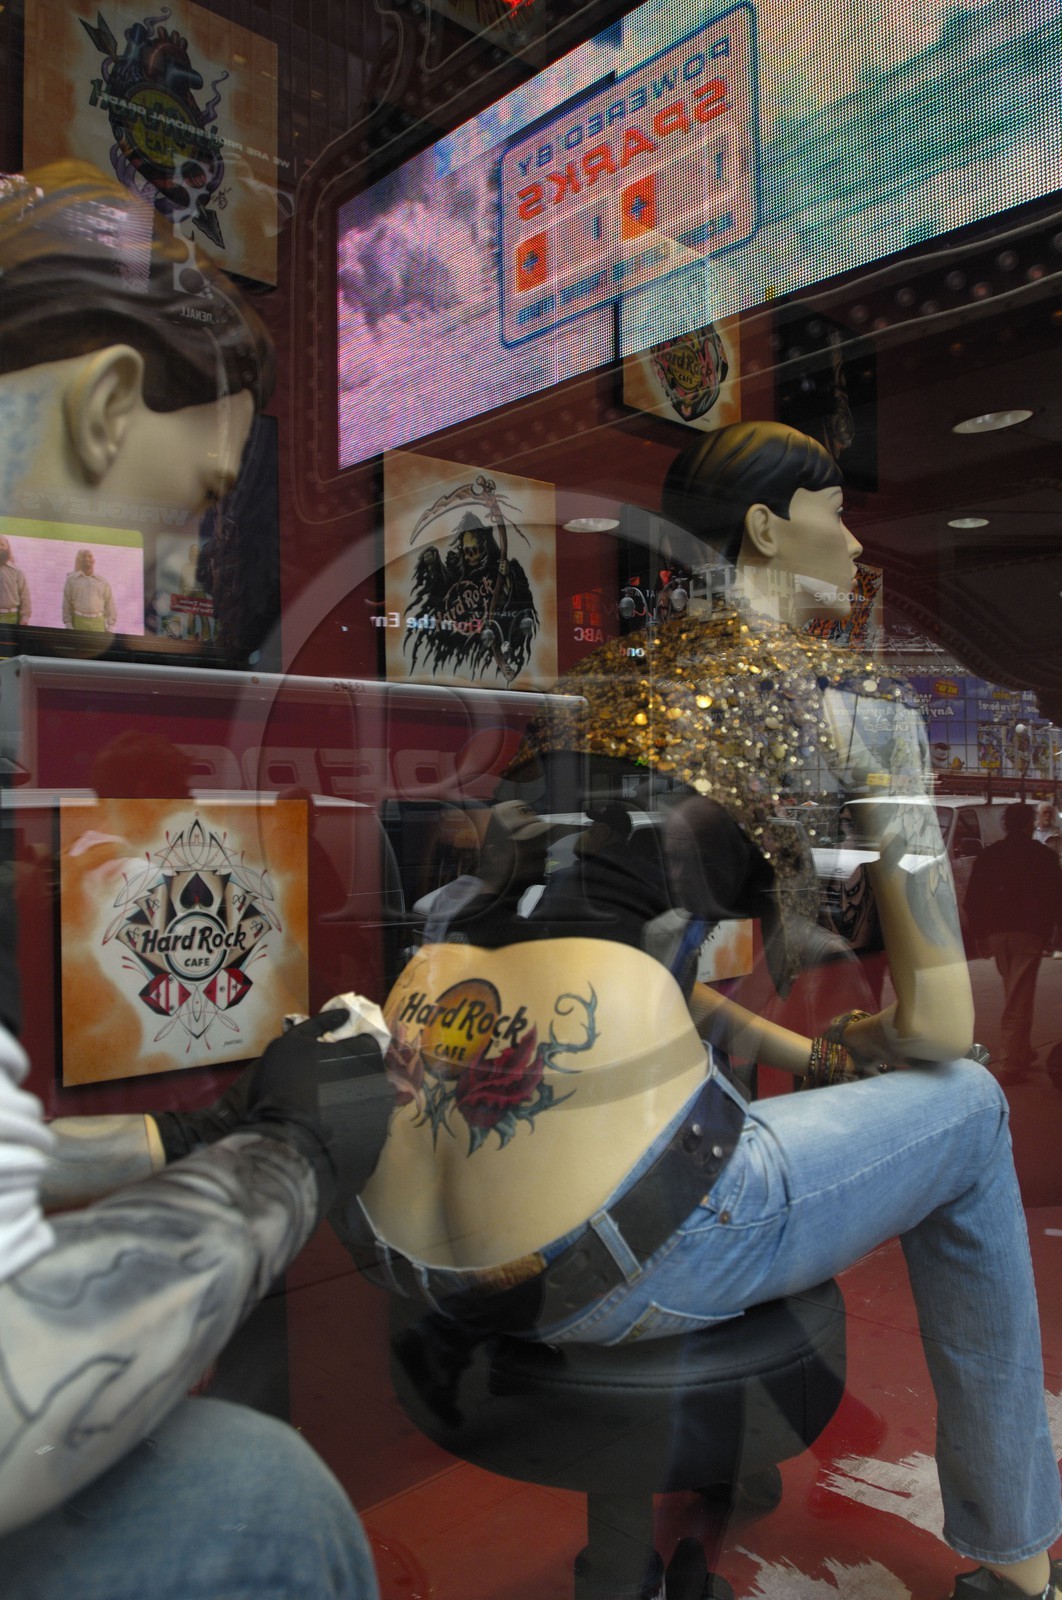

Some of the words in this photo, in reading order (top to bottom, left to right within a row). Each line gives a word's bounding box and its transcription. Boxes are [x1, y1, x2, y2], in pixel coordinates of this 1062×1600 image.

[141, 927, 195, 954] Hard
[197, 924, 247, 954] Rock
[184, 957, 211, 968] CAFE
[399, 991, 467, 1029] Hard
[459, 1000, 528, 1049] Rock
[434, 1043, 466, 1062] CAFE
